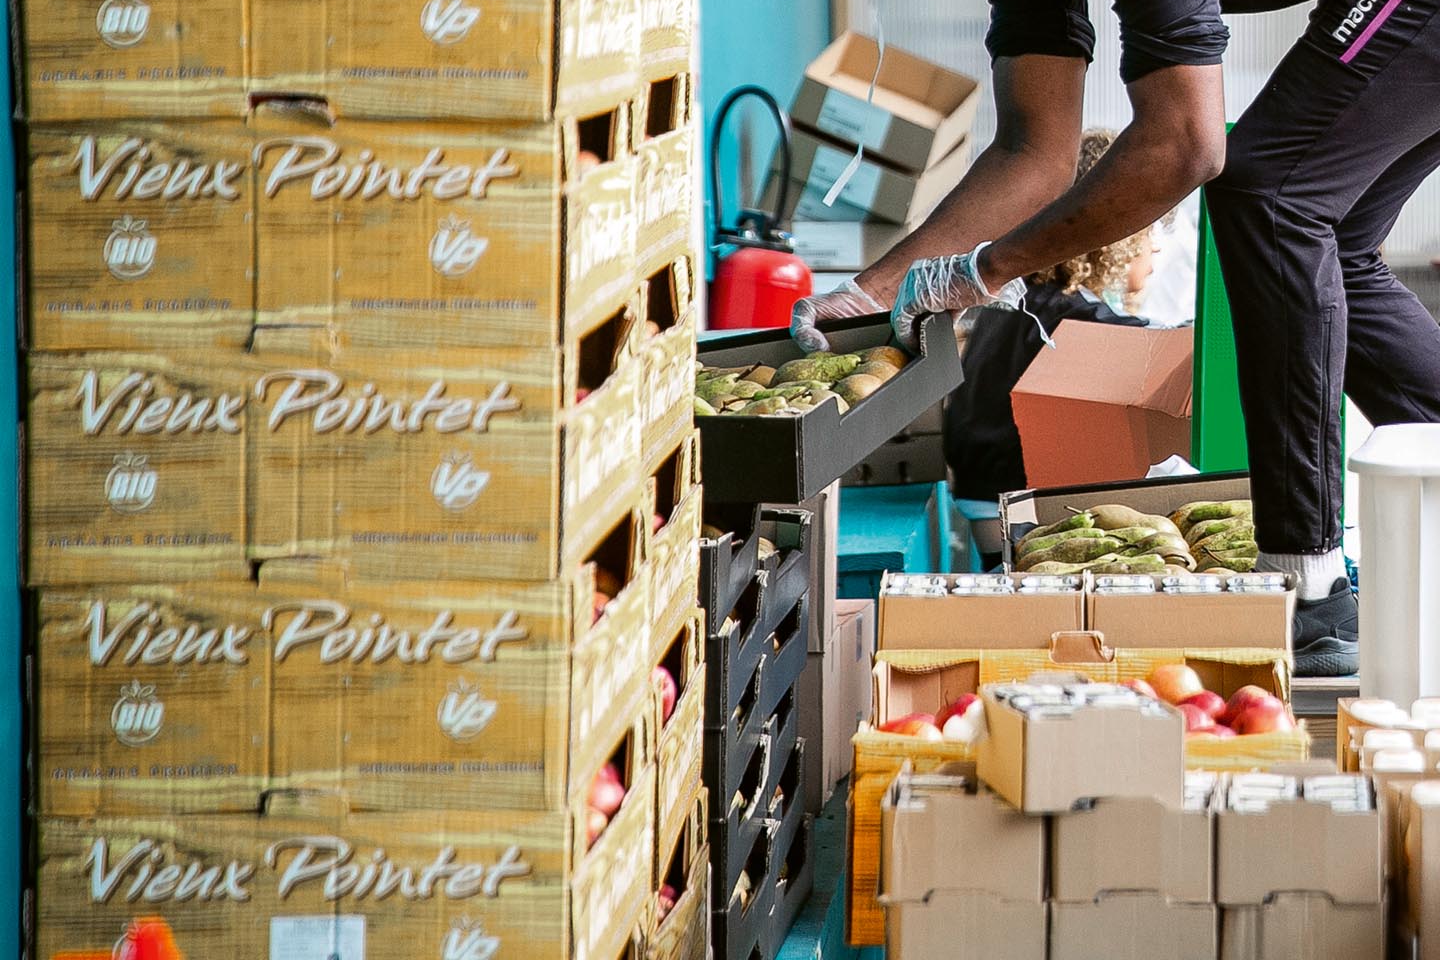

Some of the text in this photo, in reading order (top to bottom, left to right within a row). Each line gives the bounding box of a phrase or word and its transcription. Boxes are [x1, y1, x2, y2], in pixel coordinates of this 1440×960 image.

[102, 5, 150, 33] BIO
[75, 136, 521, 201] Vieux Pointet
[109, 237, 157, 265] BIO
[75, 369, 523, 434] Vieux Pointet
[109, 471, 157, 500] BIO
[84, 600, 529, 667] Vieux Pointet
[117, 702, 164, 731] BIO
[86, 836, 531, 903] Vieux Pointet
